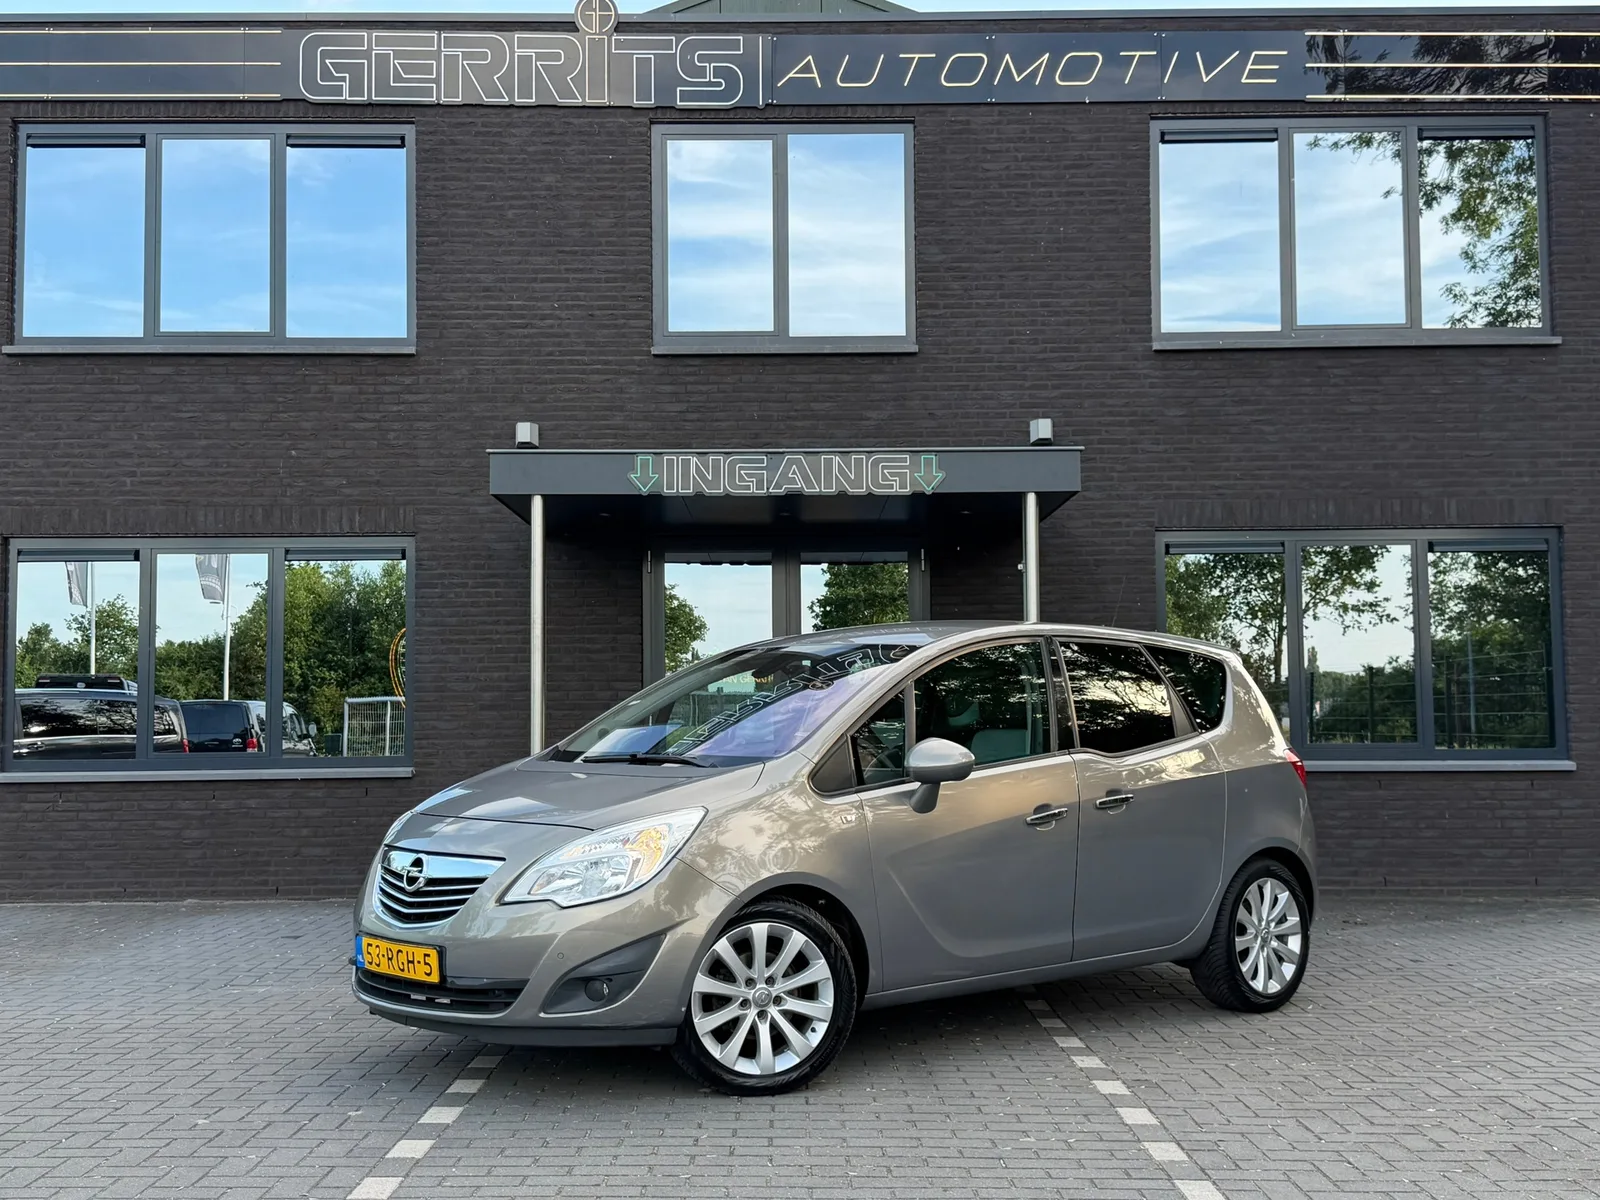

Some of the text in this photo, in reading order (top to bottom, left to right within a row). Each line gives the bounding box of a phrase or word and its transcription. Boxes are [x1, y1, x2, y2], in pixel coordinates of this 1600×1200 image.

[299, 32, 1289, 106] GERRITS AUTOMOTIVE
[663, 455, 911, 493] INGANG
[366, 942, 433, 977] 53-RGH-5
